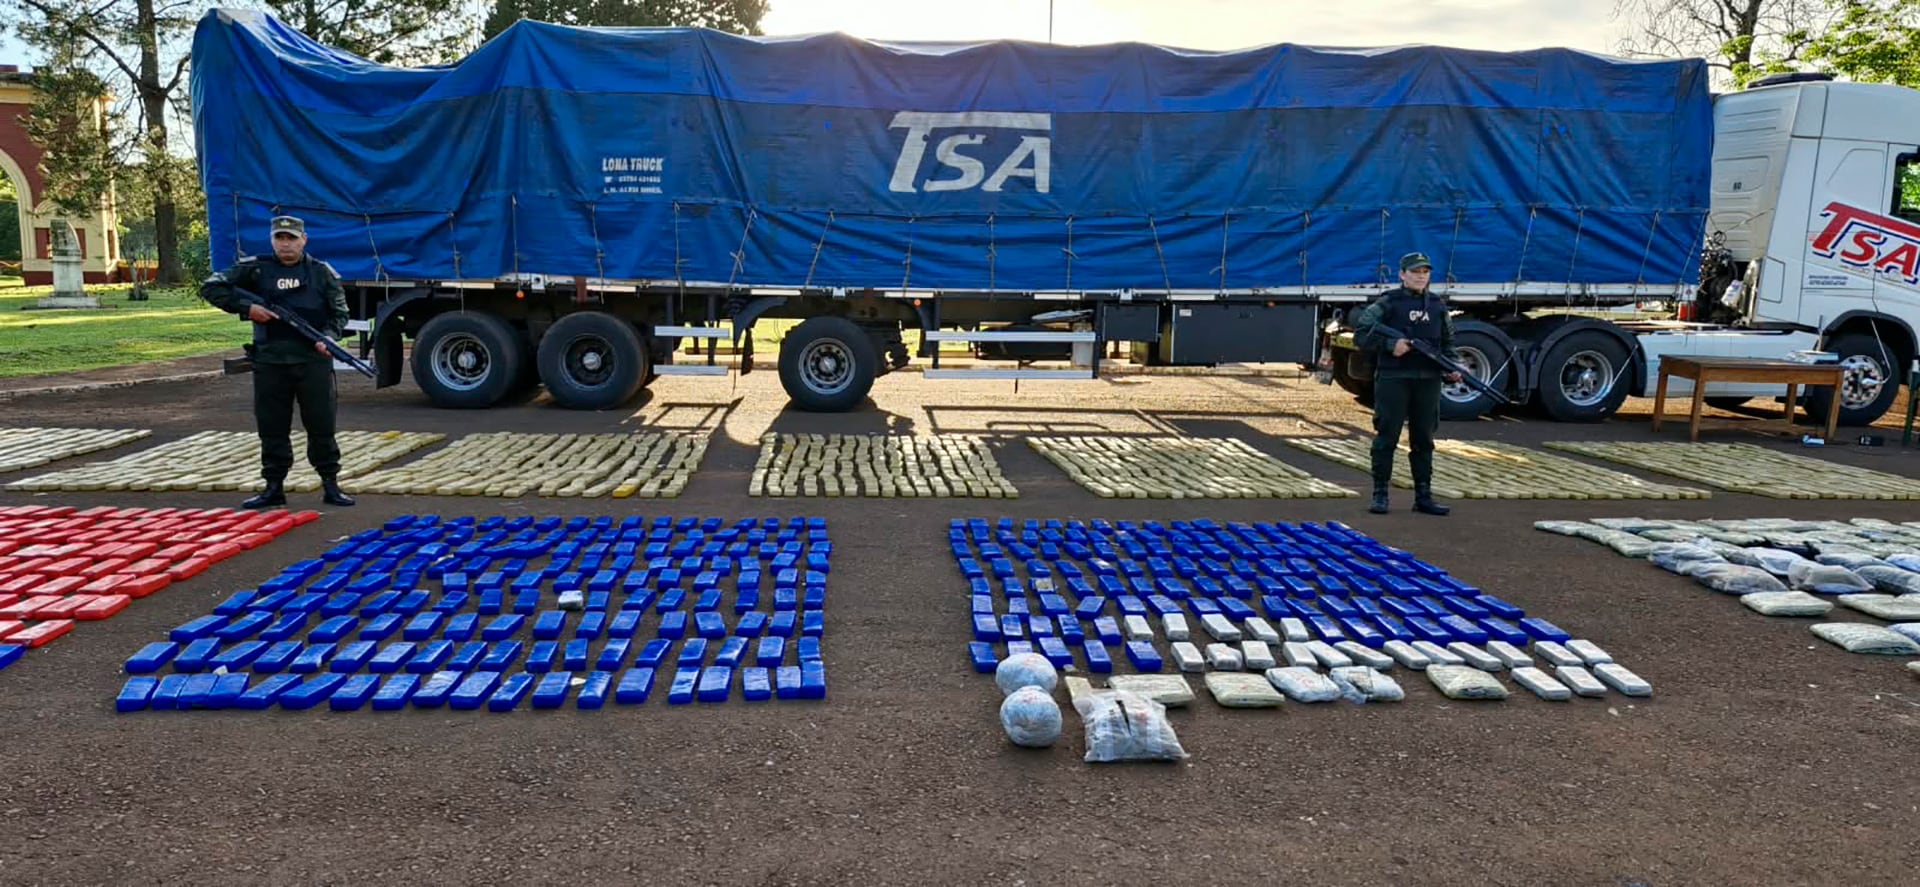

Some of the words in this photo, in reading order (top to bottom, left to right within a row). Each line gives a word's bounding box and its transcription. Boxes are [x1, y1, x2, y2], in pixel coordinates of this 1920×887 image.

[888, 111, 1051, 193] TSA
[602, 157, 628, 171] LONA
[630, 157, 663, 171] TRUCK
[1811, 201, 1920, 284] TSA
[277, 278, 300, 289] GNA
[1409, 310, 1430, 321] GNA
